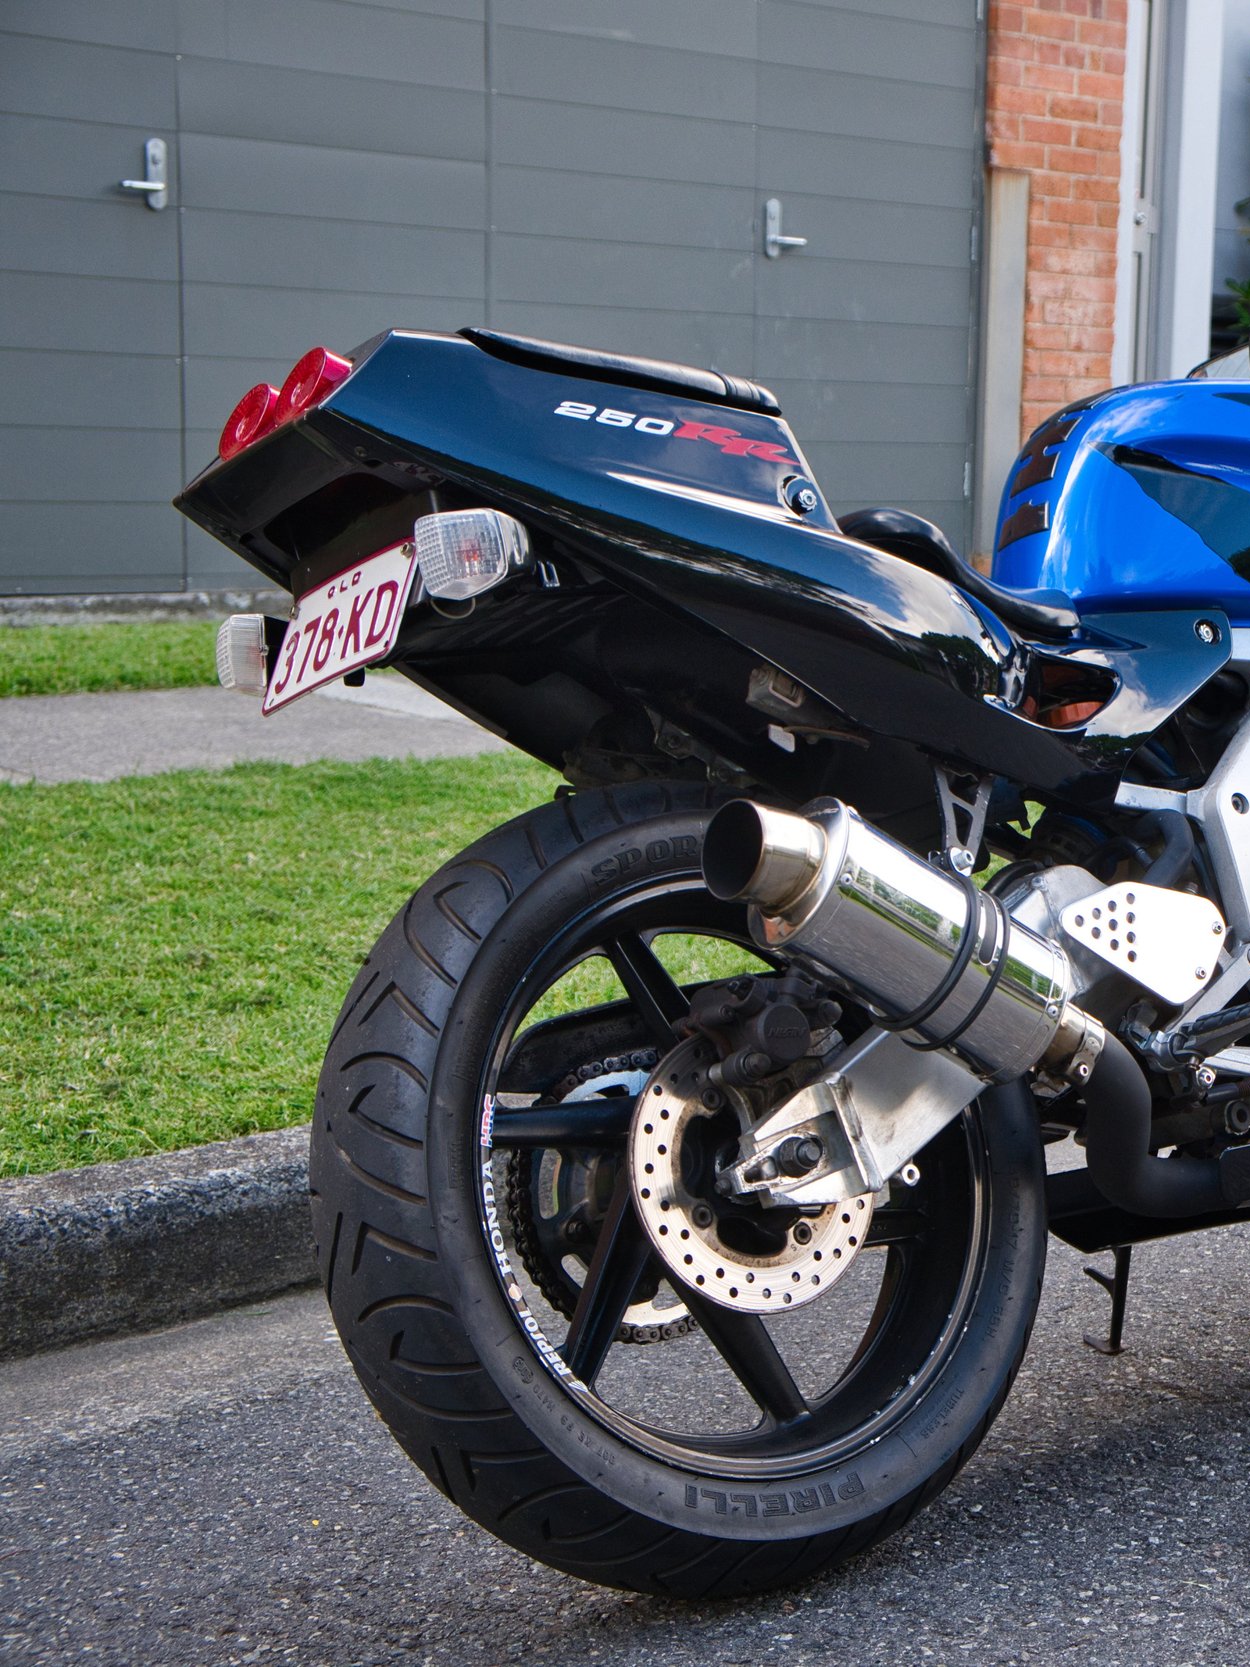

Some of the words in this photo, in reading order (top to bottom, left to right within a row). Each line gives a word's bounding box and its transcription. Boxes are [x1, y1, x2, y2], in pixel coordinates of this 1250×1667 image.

[327, 571, 362, 599] QLD
[590, 834, 706, 886] SPOR
[480, 1093, 496, 1148] HRC
[482, 1160, 513, 1277] HONDA
[518, 1309, 572, 1377] REPSOL
[684, 1471, 867, 1518] PIRELLI
